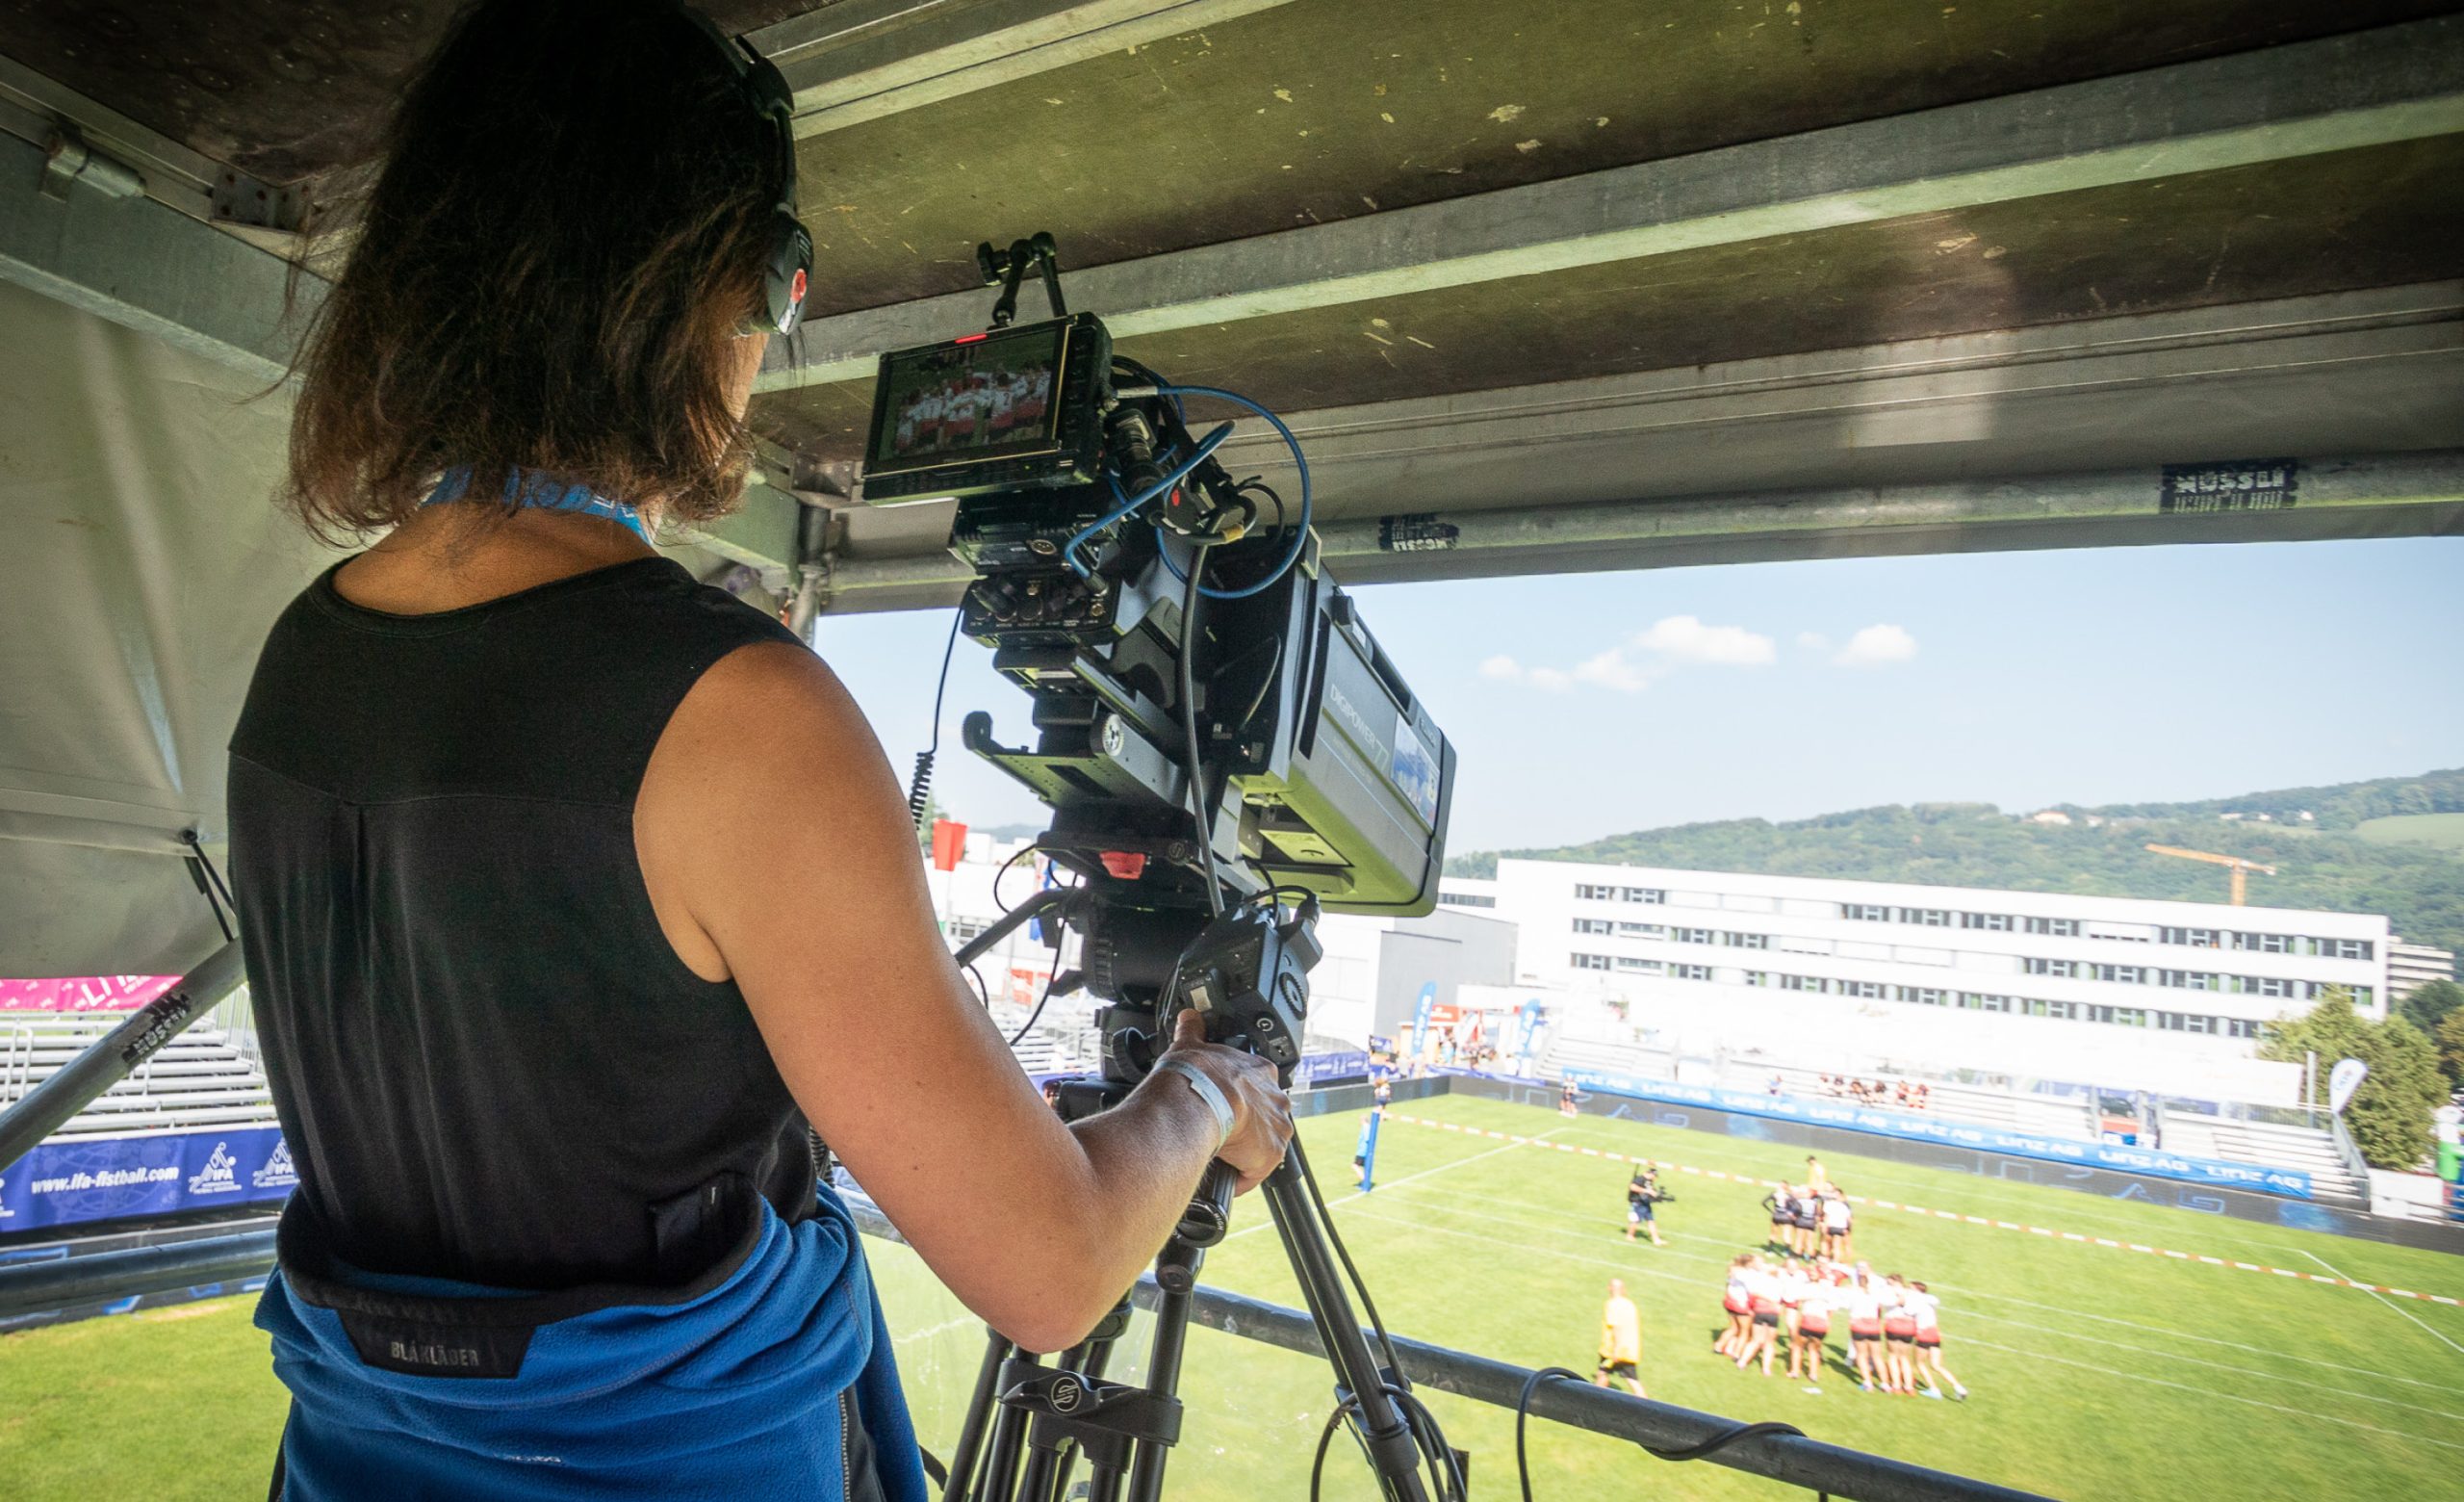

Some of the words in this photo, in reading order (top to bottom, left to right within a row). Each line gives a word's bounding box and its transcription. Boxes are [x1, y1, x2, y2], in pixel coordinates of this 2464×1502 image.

[2155, 1158, 2191, 1173] AG
[31, 1166, 180, 1195] www.ifa-fistball.com
[2266, 1174, 2304, 1190] AG
